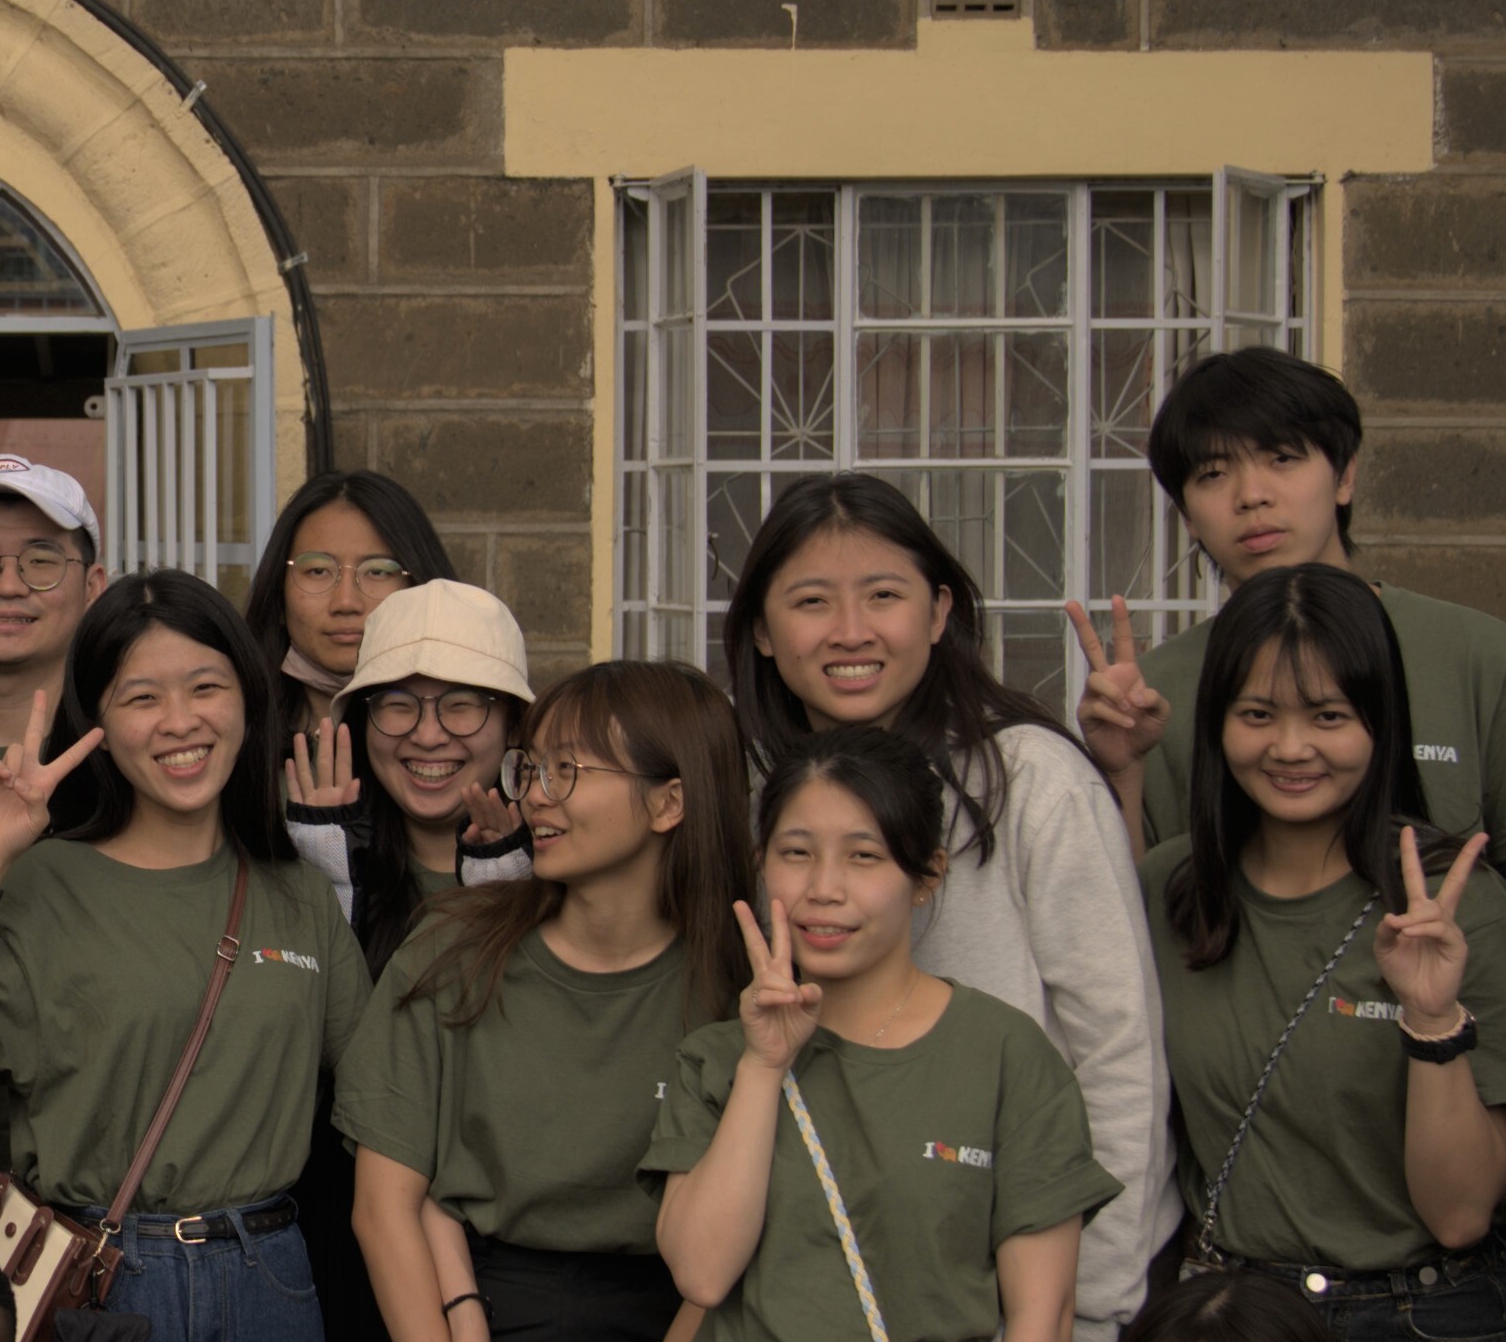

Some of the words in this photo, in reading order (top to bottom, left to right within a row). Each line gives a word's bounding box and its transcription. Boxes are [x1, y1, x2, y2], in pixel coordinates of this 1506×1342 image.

[1413, 744, 1458, 763] ENYA
[252, 950, 264, 964] I
[654, 1082, 667, 1099] I
[922, 1142, 935, 1159] I
